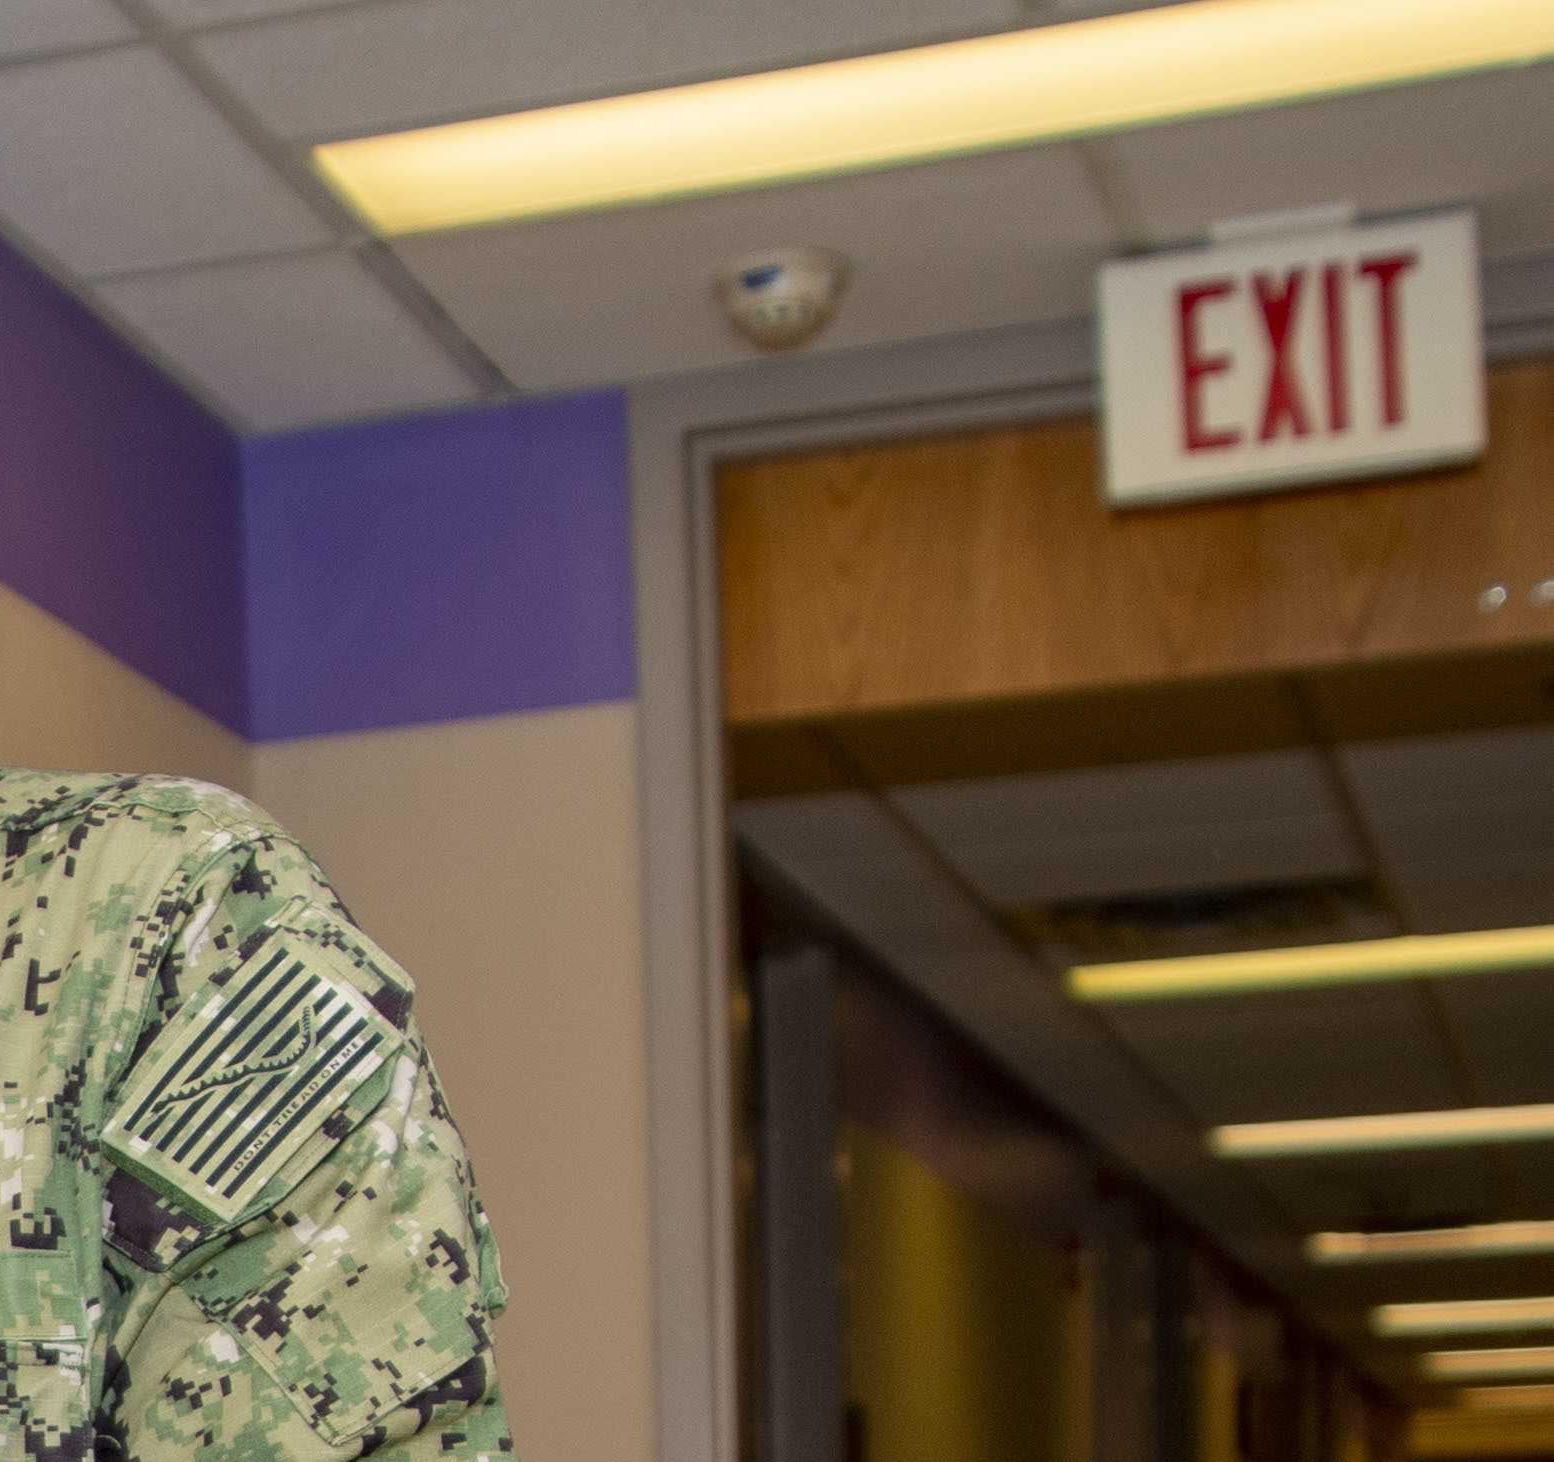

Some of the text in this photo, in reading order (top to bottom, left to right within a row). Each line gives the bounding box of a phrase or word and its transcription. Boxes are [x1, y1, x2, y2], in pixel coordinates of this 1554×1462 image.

[1174, 249, 1419, 456] EXIT
[233, 1041, 360, 1172] DONT TREAD ON ME
